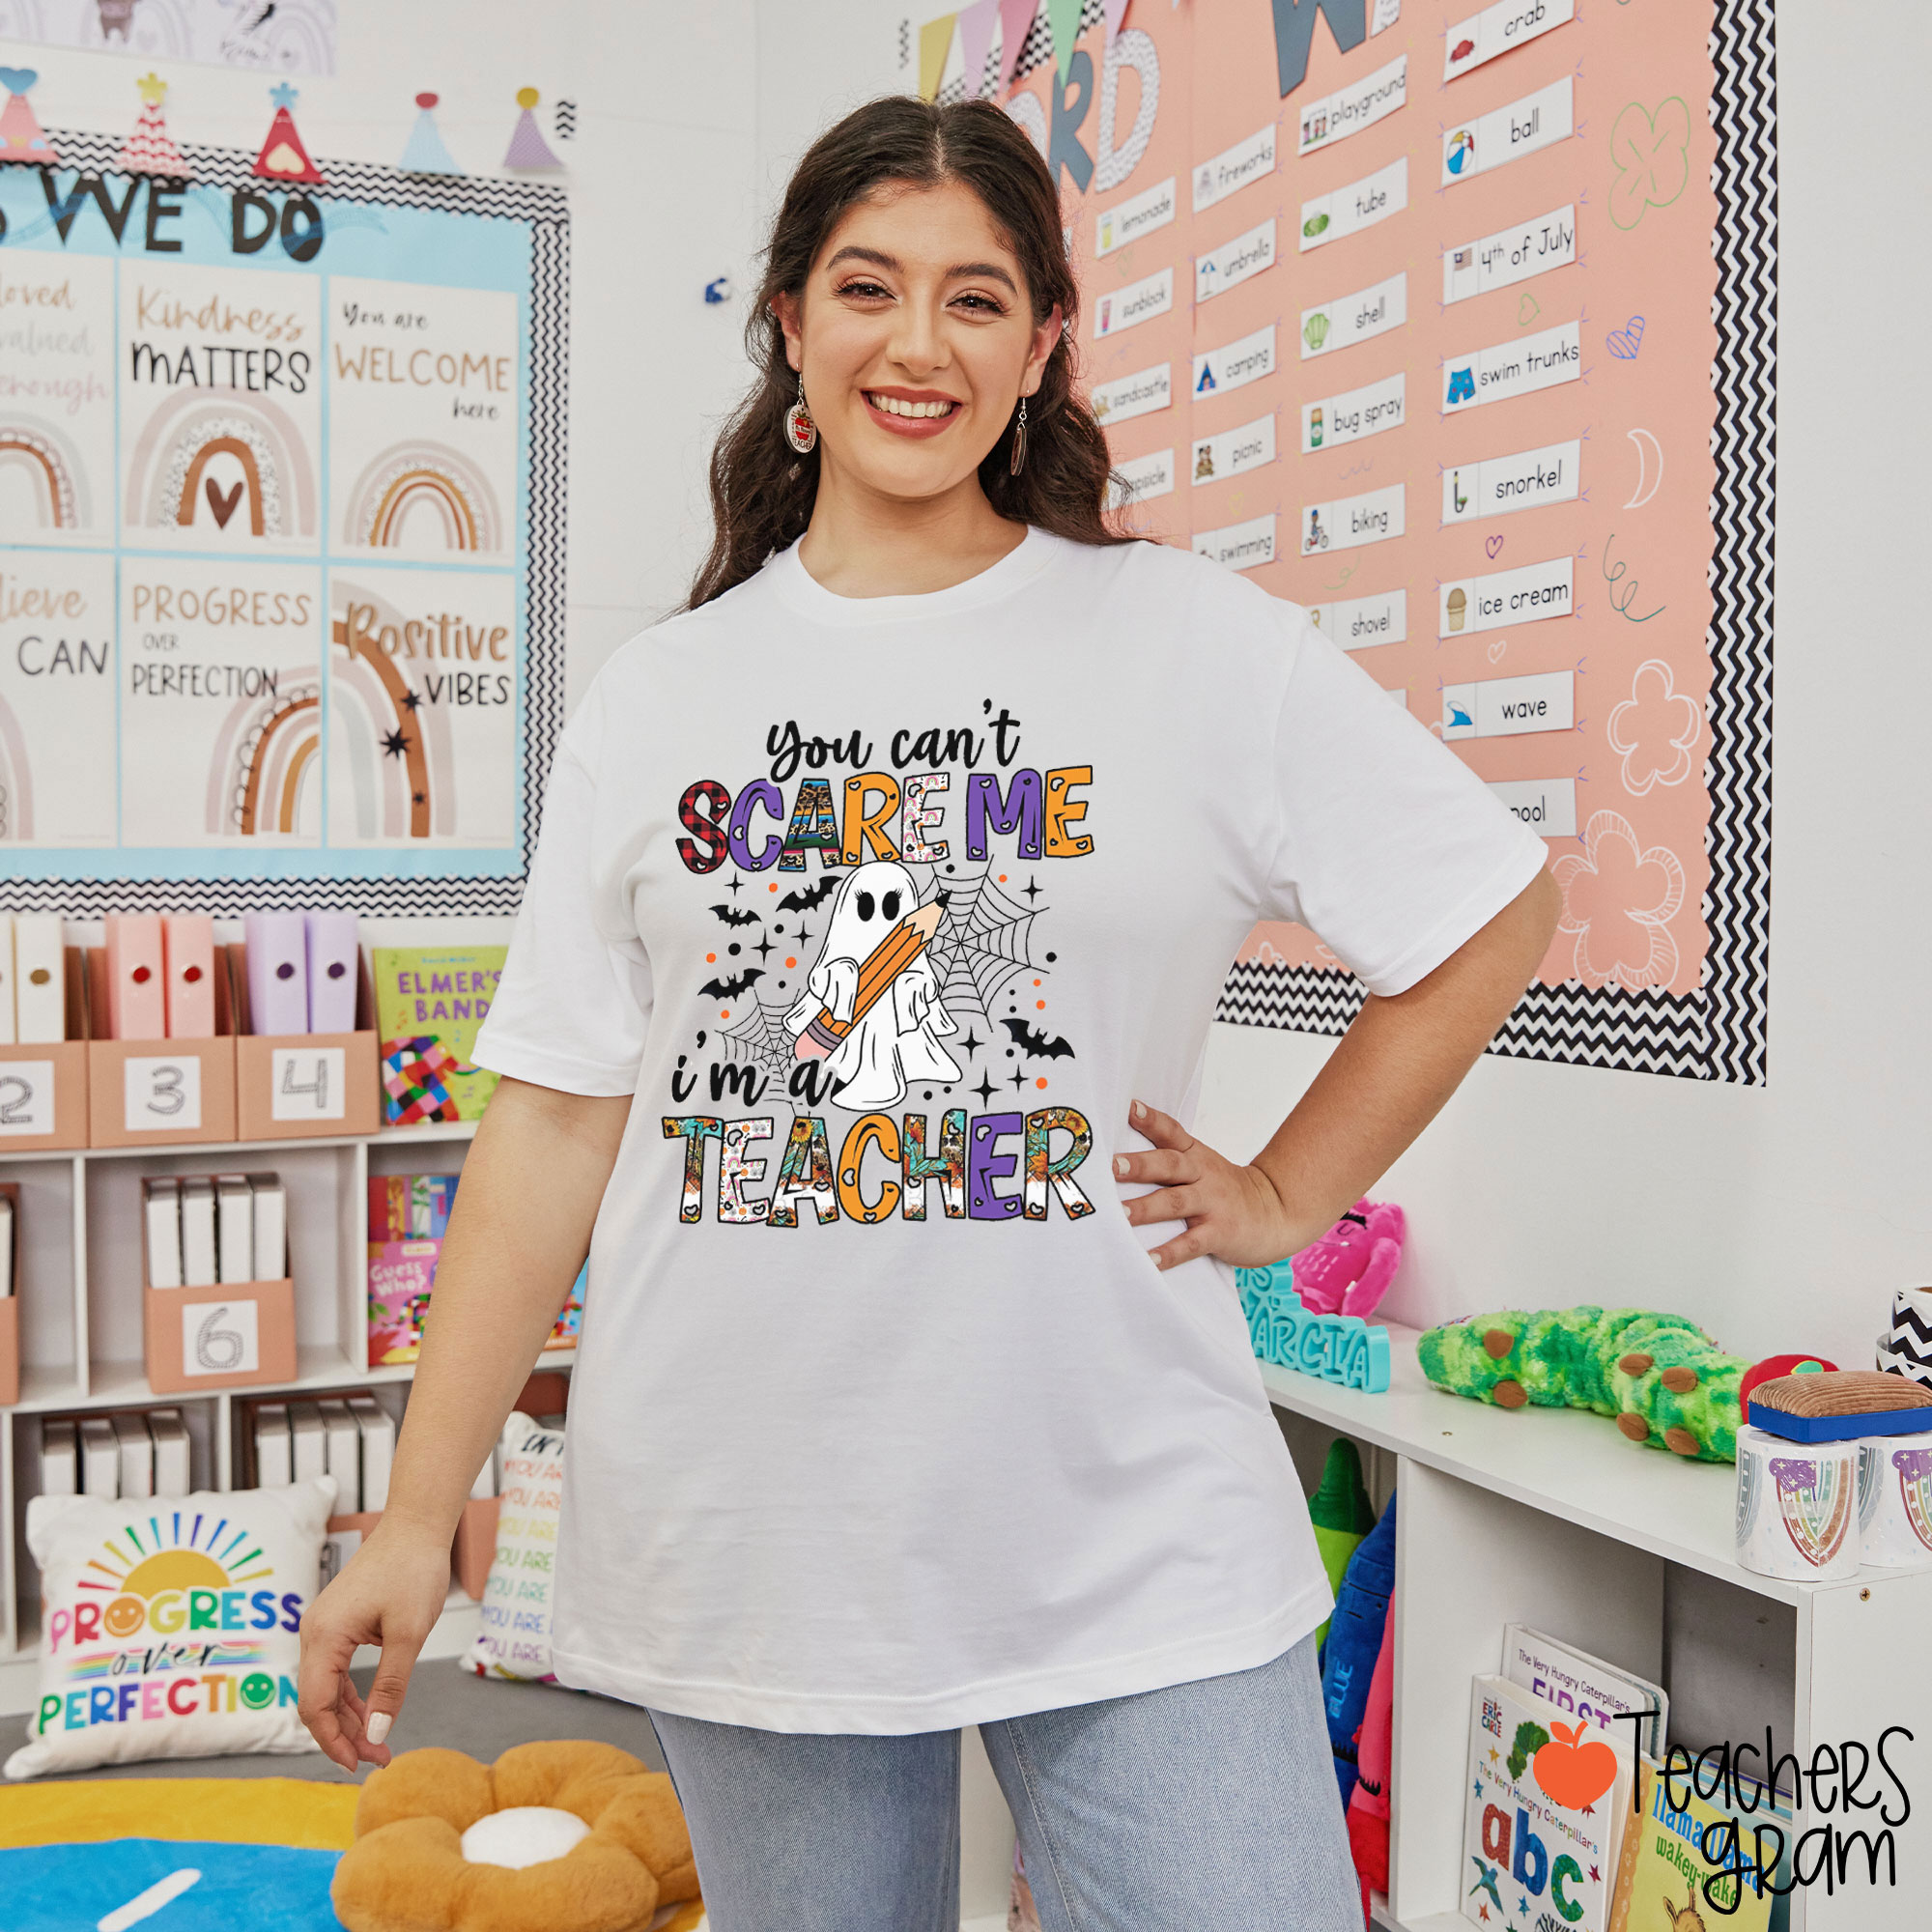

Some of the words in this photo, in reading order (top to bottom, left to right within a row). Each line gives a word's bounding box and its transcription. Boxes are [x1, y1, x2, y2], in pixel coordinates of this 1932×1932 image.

[1504, 0, 1546, 37] crab
[1330, 64, 1407, 131] playground
[1510, 106, 1540, 144] ball
[1218, 142, 1274, 187] fireworks
[39, 168, 188, 253] WE
[231, 185, 327, 263] DO
[1121, 193, 1172, 233] lemonade
[1355, 187, 1387, 218] tube
[1224, 237, 1270, 278] umbrella
[1481, 242, 1505, 274] 4th
[1511, 234, 1531, 267] of
[1538, 221, 1574, 256] July
[136, 284, 306, 344] Kindness
[343, 302, 387, 329] You
[394, 311, 429, 330] are
[1122, 284, 1167, 320] sunblock
[1355, 297, 1385, 329] shell
[334, 343, 512, 392] WELCOME
[1226, 349, 1269, 379] camping
[1480, 361, 1520, 386] swim
[1526, 340, 1579, 373] trunks
[453, 397, 499, 421] here
[1114, 374, 1169, 408] sandcastle
[1333, 407, 1360, 433] bug
[1365, 394, 1403, 425] spray
[1232, 438, 1263, 469] picnic
[1495, 459, 1562, 500] snorkel
[1351, 509, 1388, 534] biking
[1219, 536, 1272, 563] swimming
[132, 584, 313, 626] PROGRESS
[1478, 596, 1503, 616] ice
[1511, 582, 1569, 611] cream
[143, 633, 181, 651] OVER
[347, 601, 509, 663] Positive
[1351, 608, 1391, 637] shovel
[17, 635, 109, 676] CAN
[131, 665, 278, 698] PERFECTION
[424, 671, 512, 707] VIBES
[1501, 696, 1548, 721] wave
[891, 697, 1021, 770] can't
[675, 770, 951, 875] SCARE
[965, 765, 1095, 861] ME
[414, 998, 491, 1023] BAND
[281, 1058, 328, 1110] 4
[671, 1030, 773, 1107] i'm
[789, 1058, 840, 1109] a
[0, 1076, 34, 1124] 2
[147, 1065, 186, 1116] 3
[661, 1106, 1096, 1229] TEACHER
[370, 1262, 423, 1283] Guess
[375, 1272, 428, 1297] Who?
[196, 1307, 244, 1370] 6
[1244, 1304, 1370, 1387] ARCIA
[513, 1609, 546, 1634] ARE
[110, 1641, 249, 1676] over
[1327, 1658, 1354, 1719] BLUE
[1519, 1647, 1532, 1666] The
[1533, 1655, 1550, 1676] Very
[1551, 1662, 1579, 1691] Hungry
[1580, 1679, 1631, 1715] Caterpillar's
[1481, 1714, 1502, 1739] CARLE
[1483, 1701, 1503, 1725] ERIC
[1479, 1760, 1492, 1780] The
[1493, 1772, 1513, 1798] Very
[1513, 1785, 1543, 1820] Hungry
[1544, 1808, 1599, 1856] Caterpillar's
[1481, 1803, 1585, 1923] abc
